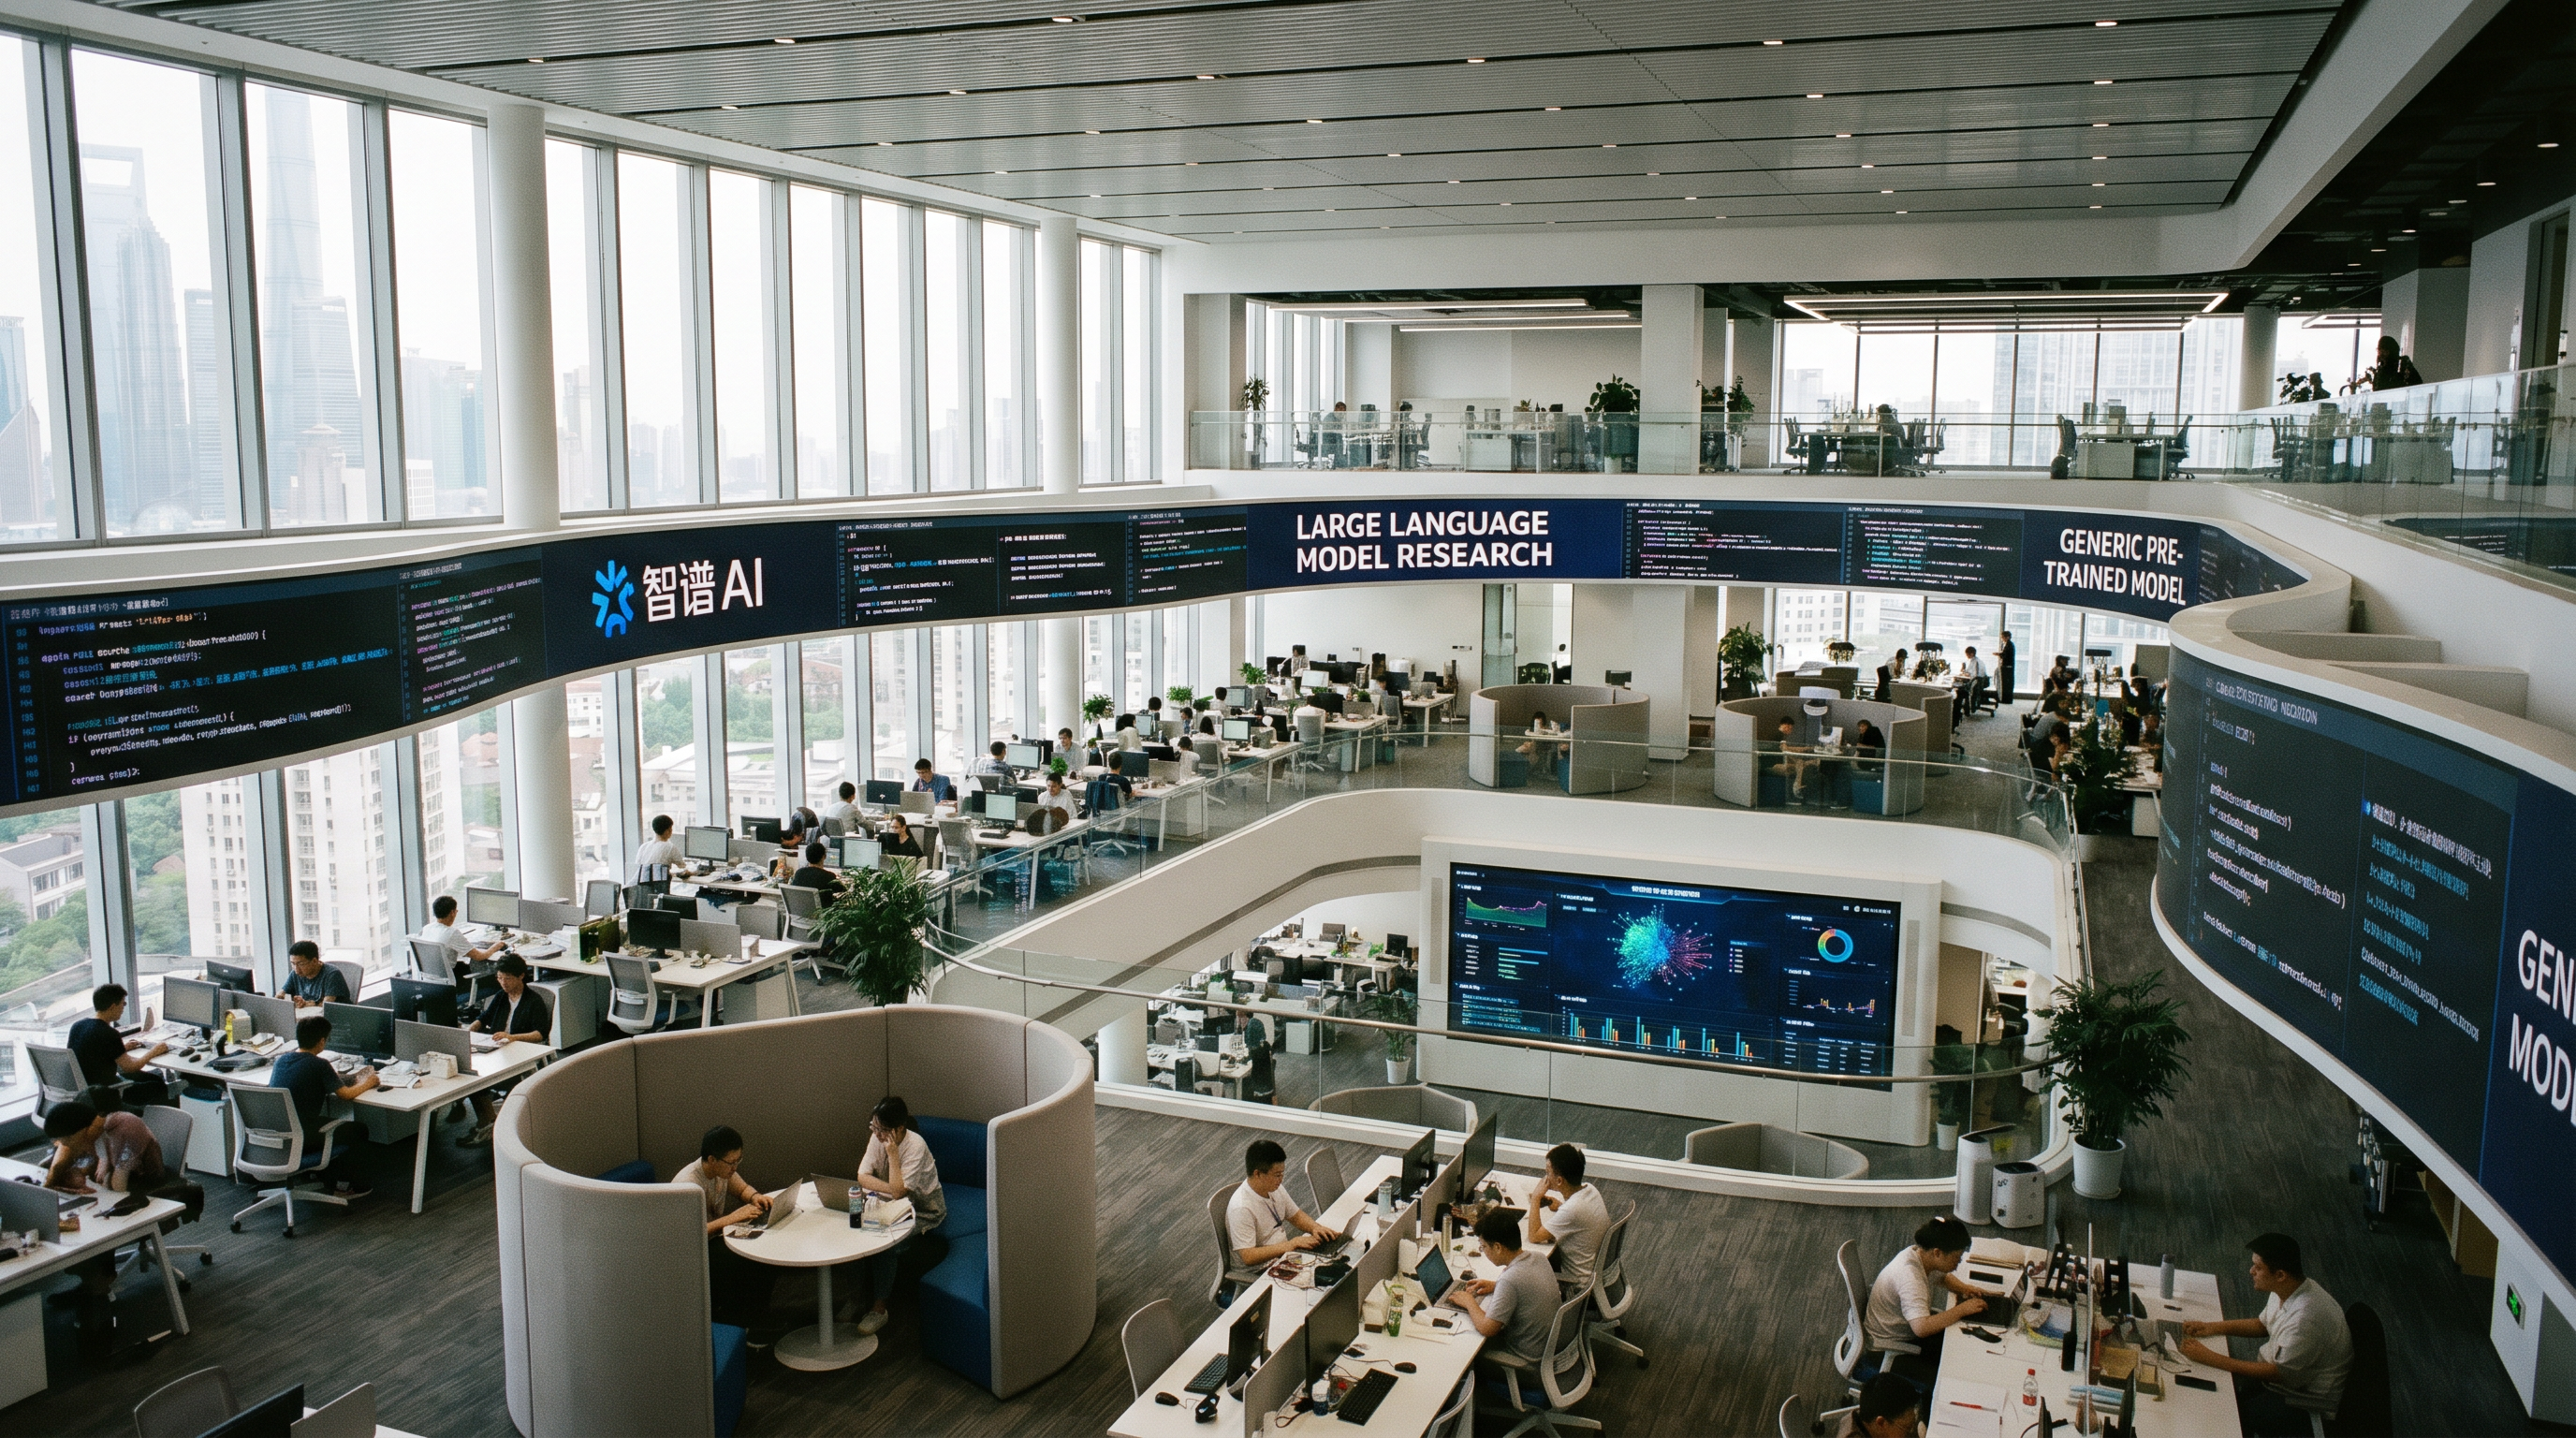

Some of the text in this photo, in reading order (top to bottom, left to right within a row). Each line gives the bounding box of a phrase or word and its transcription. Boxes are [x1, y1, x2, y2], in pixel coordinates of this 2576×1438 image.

[1296, 510, 1549, 540] LARGE LANGUAGE
[1296, 541, 1553, 574] MODEL RESEARCH
[2059, 528, 2144, 562] GENERIC
[2145, 535, 2184, 566] PRE-
[2042, 560, 2187, 606] TRAINED MODEL
[2517, 929, 2576, 1026] GEN
[2509, 1012, 2576, 1128] MOD
